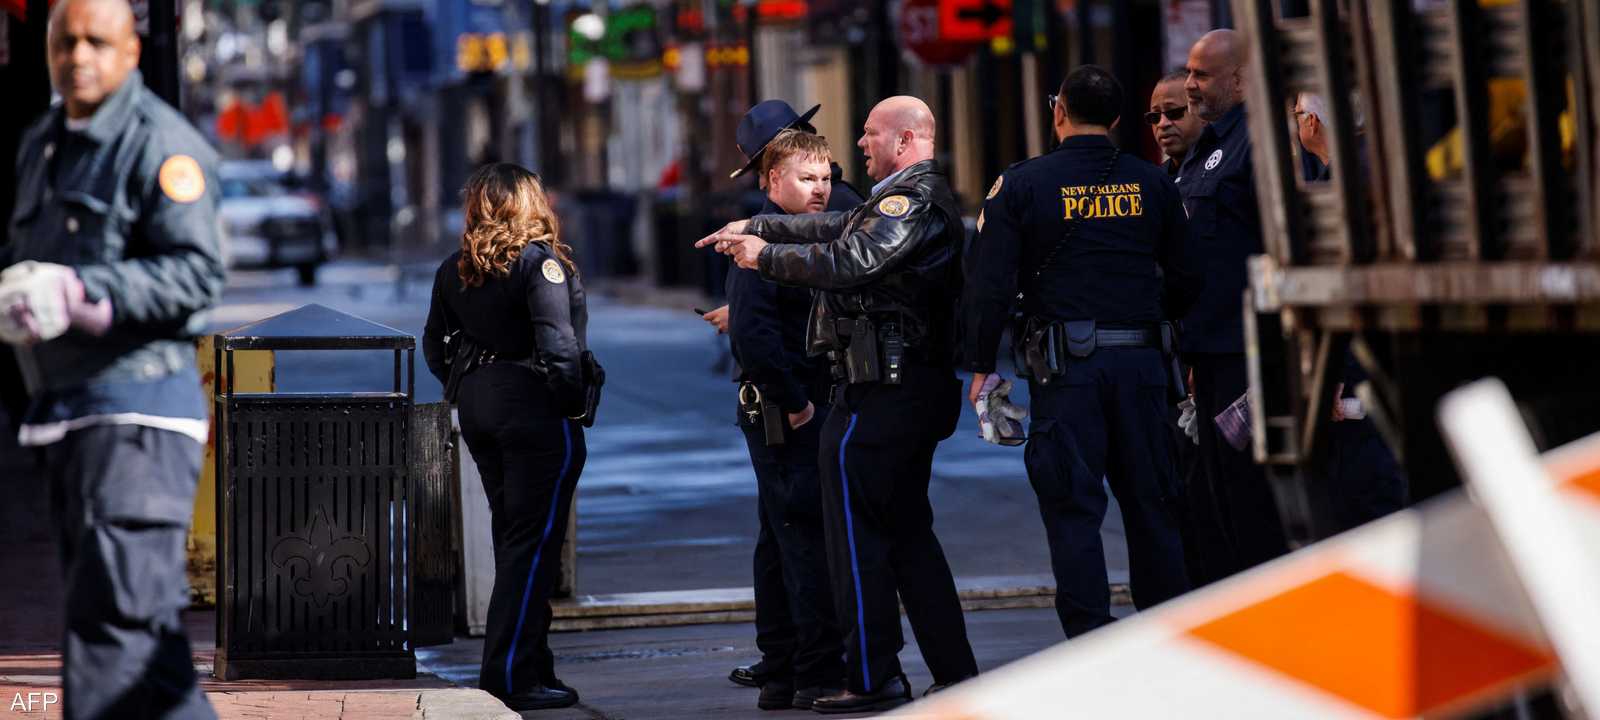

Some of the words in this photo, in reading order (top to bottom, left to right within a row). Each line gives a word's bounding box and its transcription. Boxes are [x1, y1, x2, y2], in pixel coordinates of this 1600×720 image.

[903, 7, 938, 41] ST
[1061, 186, 1087, 196] NEW
[1063, 194, 1142, 219] POLICE
